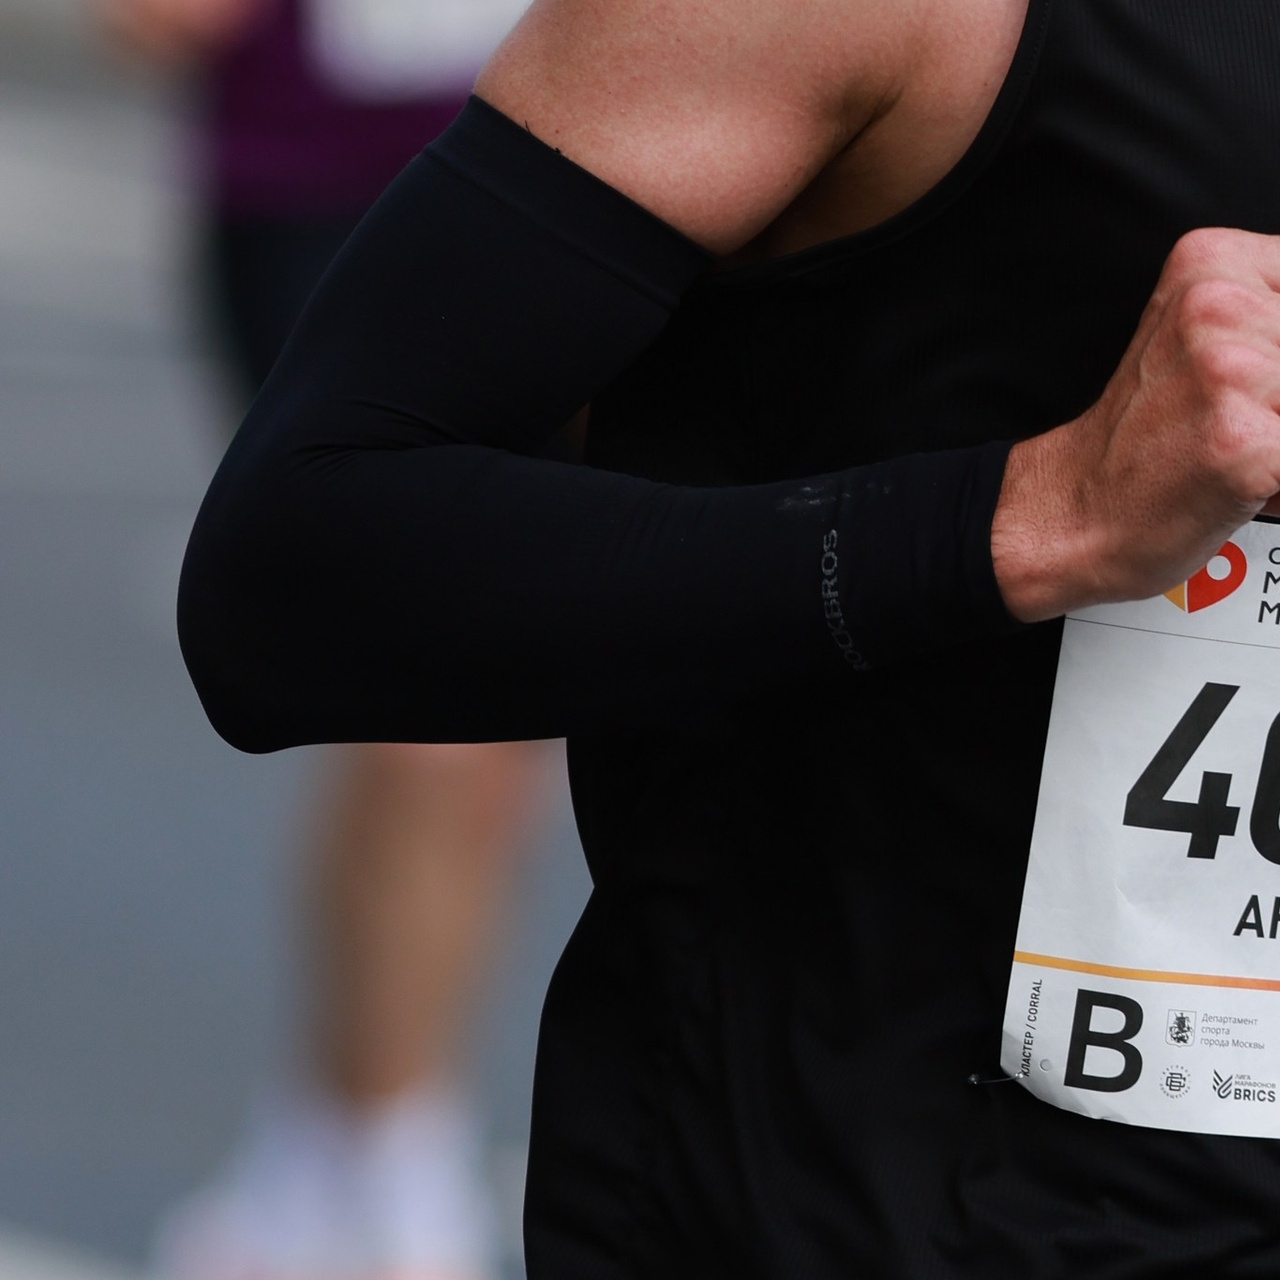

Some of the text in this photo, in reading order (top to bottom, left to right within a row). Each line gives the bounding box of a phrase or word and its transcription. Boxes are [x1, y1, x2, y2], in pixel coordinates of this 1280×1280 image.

[1201, 1013, 1258, 1026] Департамент
[1019, 1031, 1035, 1077] КЛАСТЕР
[1027, 979, 1043, 1023] CORRAL
[1201, 1026, 1230, 1036] спорта
[1200, 1038, 1265, 1050] города Москвы
[1233, 1088, 1276, 1103] BRICS
